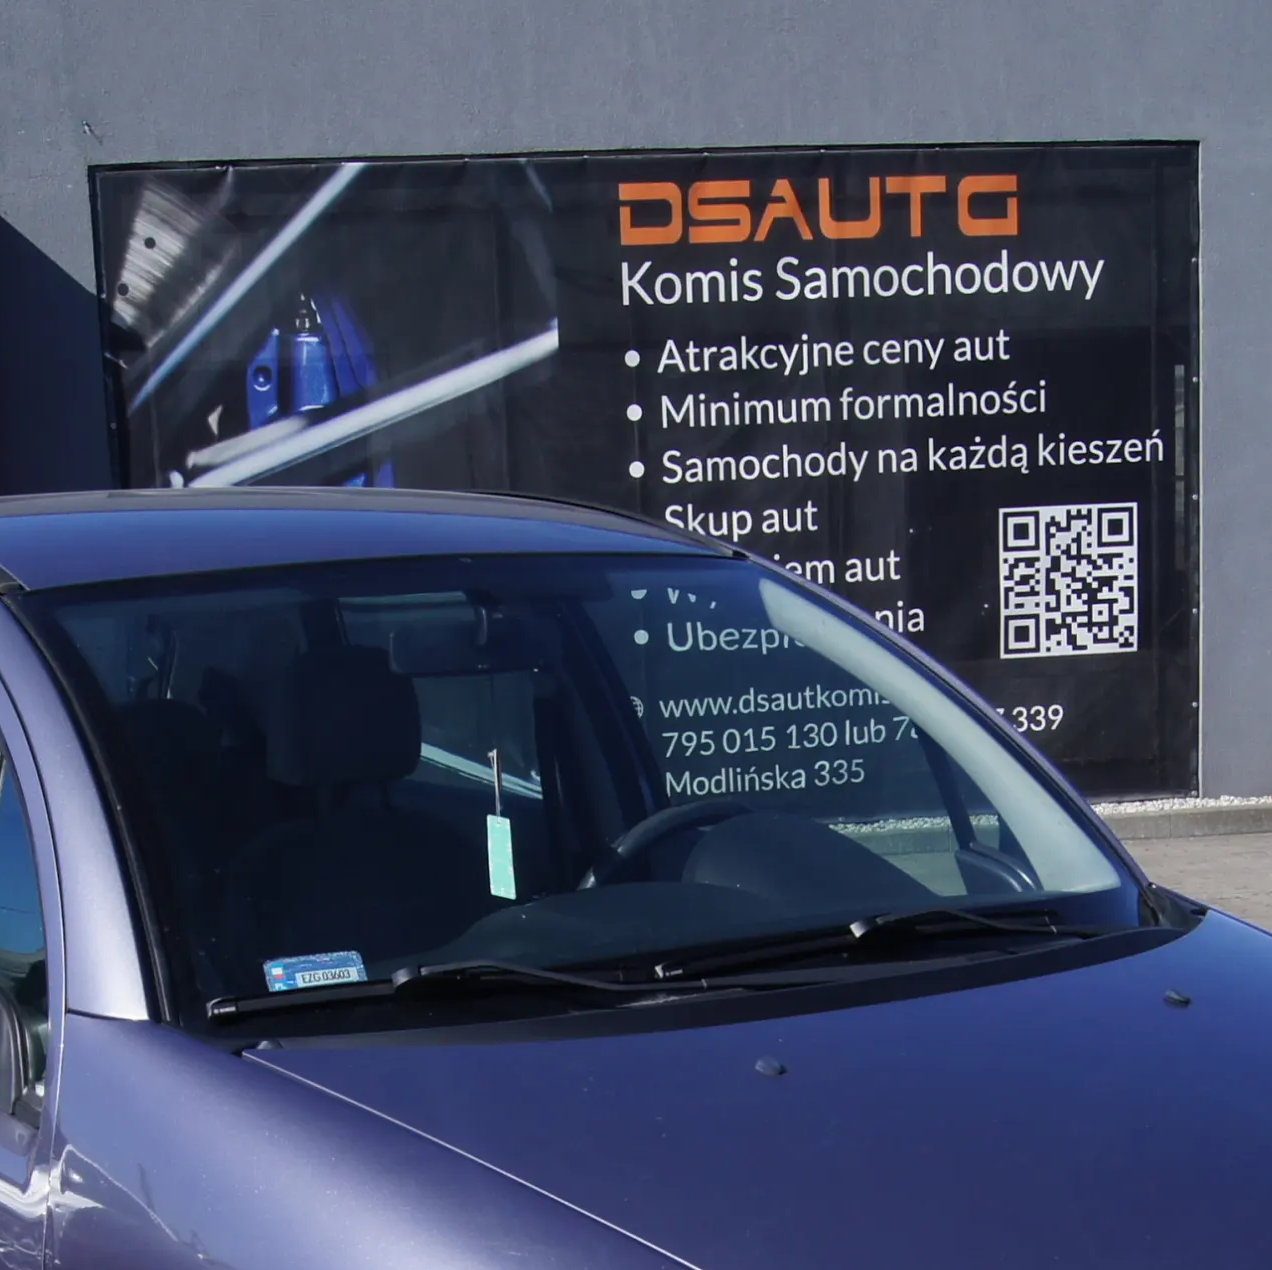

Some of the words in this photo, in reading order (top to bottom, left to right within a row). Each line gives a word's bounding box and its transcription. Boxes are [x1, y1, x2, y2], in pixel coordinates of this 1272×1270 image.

[620, 257, 763, 306] Komis
[775, 249, 1105, 302] Samochodowy
[657, 333, 855, 377] Atrakcyjne
[862, 338, 946, 371] ceny
[953, 329, 1011, 361] aut
[661, 391, 832, 429] Minimum
[839, 380, 1047, 421] formalności
[661, 442, 868, 485] Samochody
[877, 446, 919, 474] na
[927, 437, 1029, 475] każdą
[1038, 428, 1165, 468] kieszeń
[665, 504, 752, 542] Skup
[761, 500, 818, 533] aut
[844, 549, 901, 583] aut
[661, 729, 715, 758] 795
[722, 726, 777, 754] 015
[785, 722, 838, 751] 130
[844, 716, 886, 746] lub
[665, 766, 807, 797] Modlińska
[813, 759, 866, 787] 335
